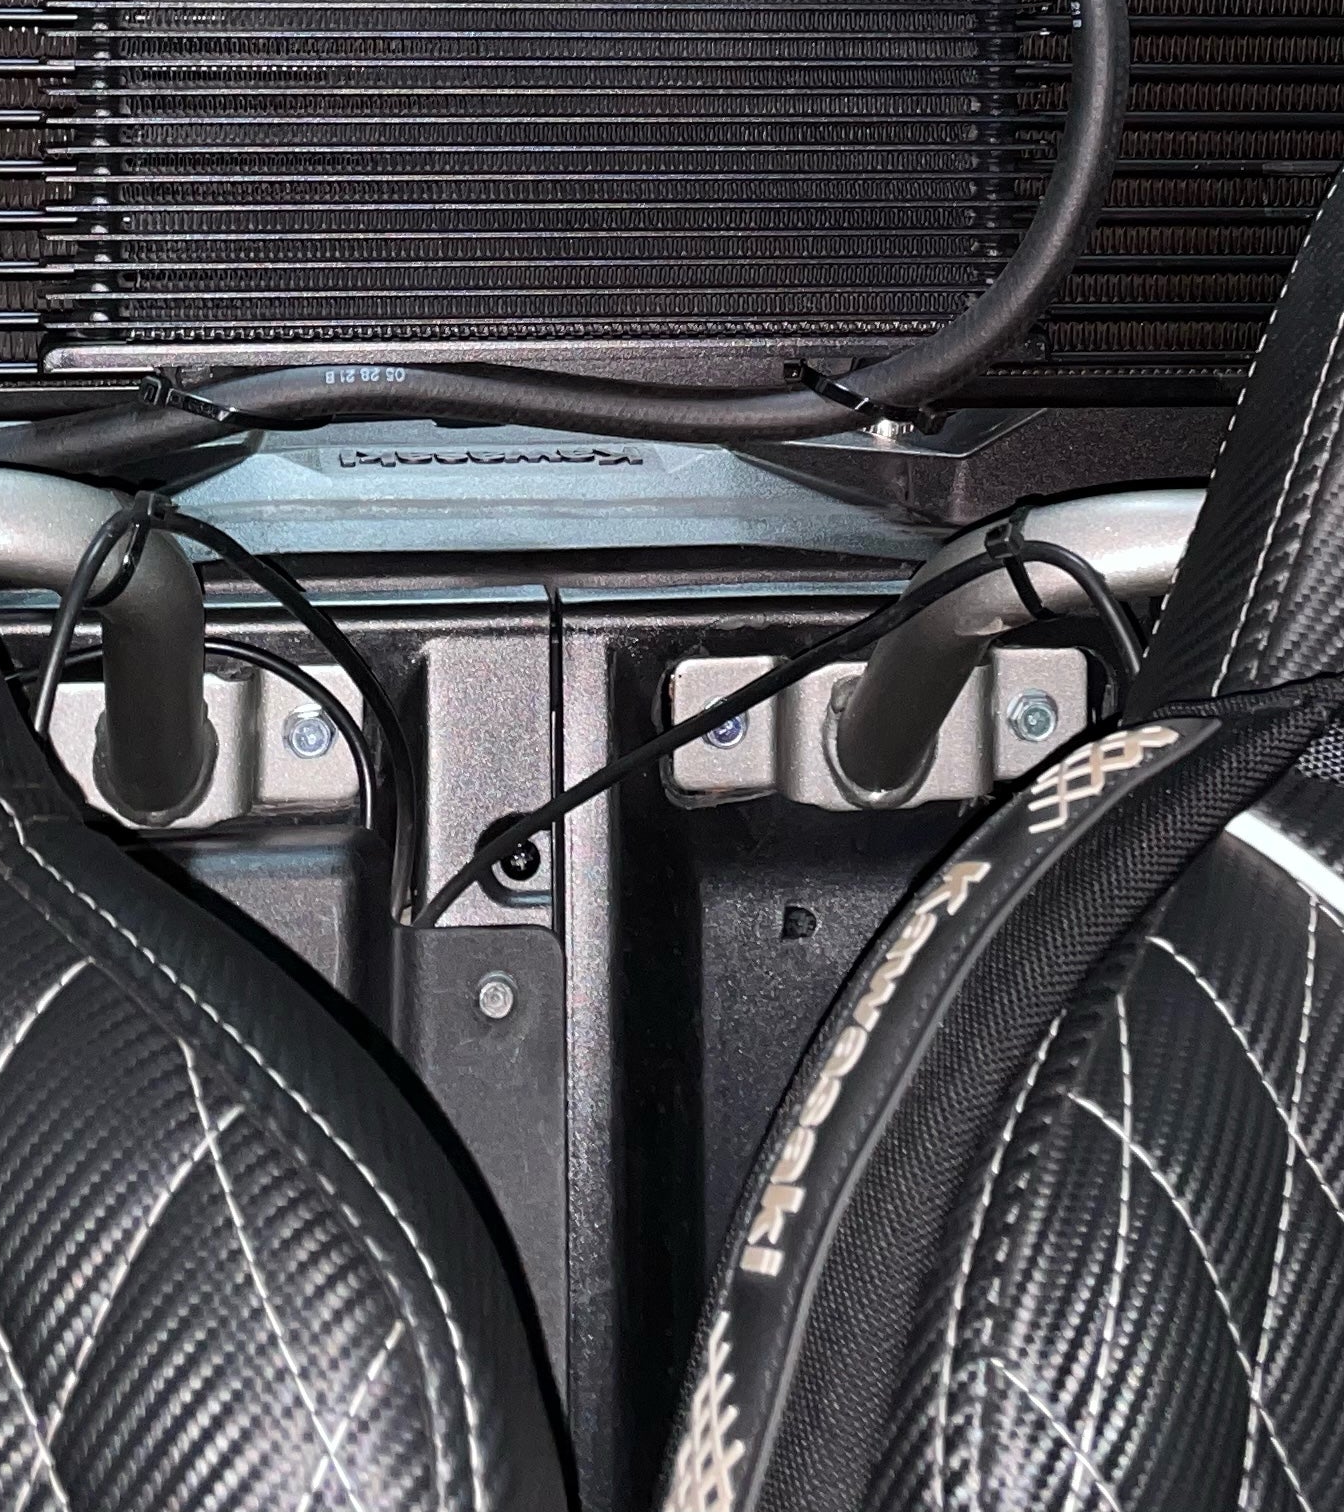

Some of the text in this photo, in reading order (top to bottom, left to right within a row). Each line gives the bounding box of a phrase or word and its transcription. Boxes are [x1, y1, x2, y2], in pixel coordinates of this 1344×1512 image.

[359, 367, 380, 382] 28
[385, 367, 405, 382] 05
[741, 861, 991, 1276] Kawasaki
